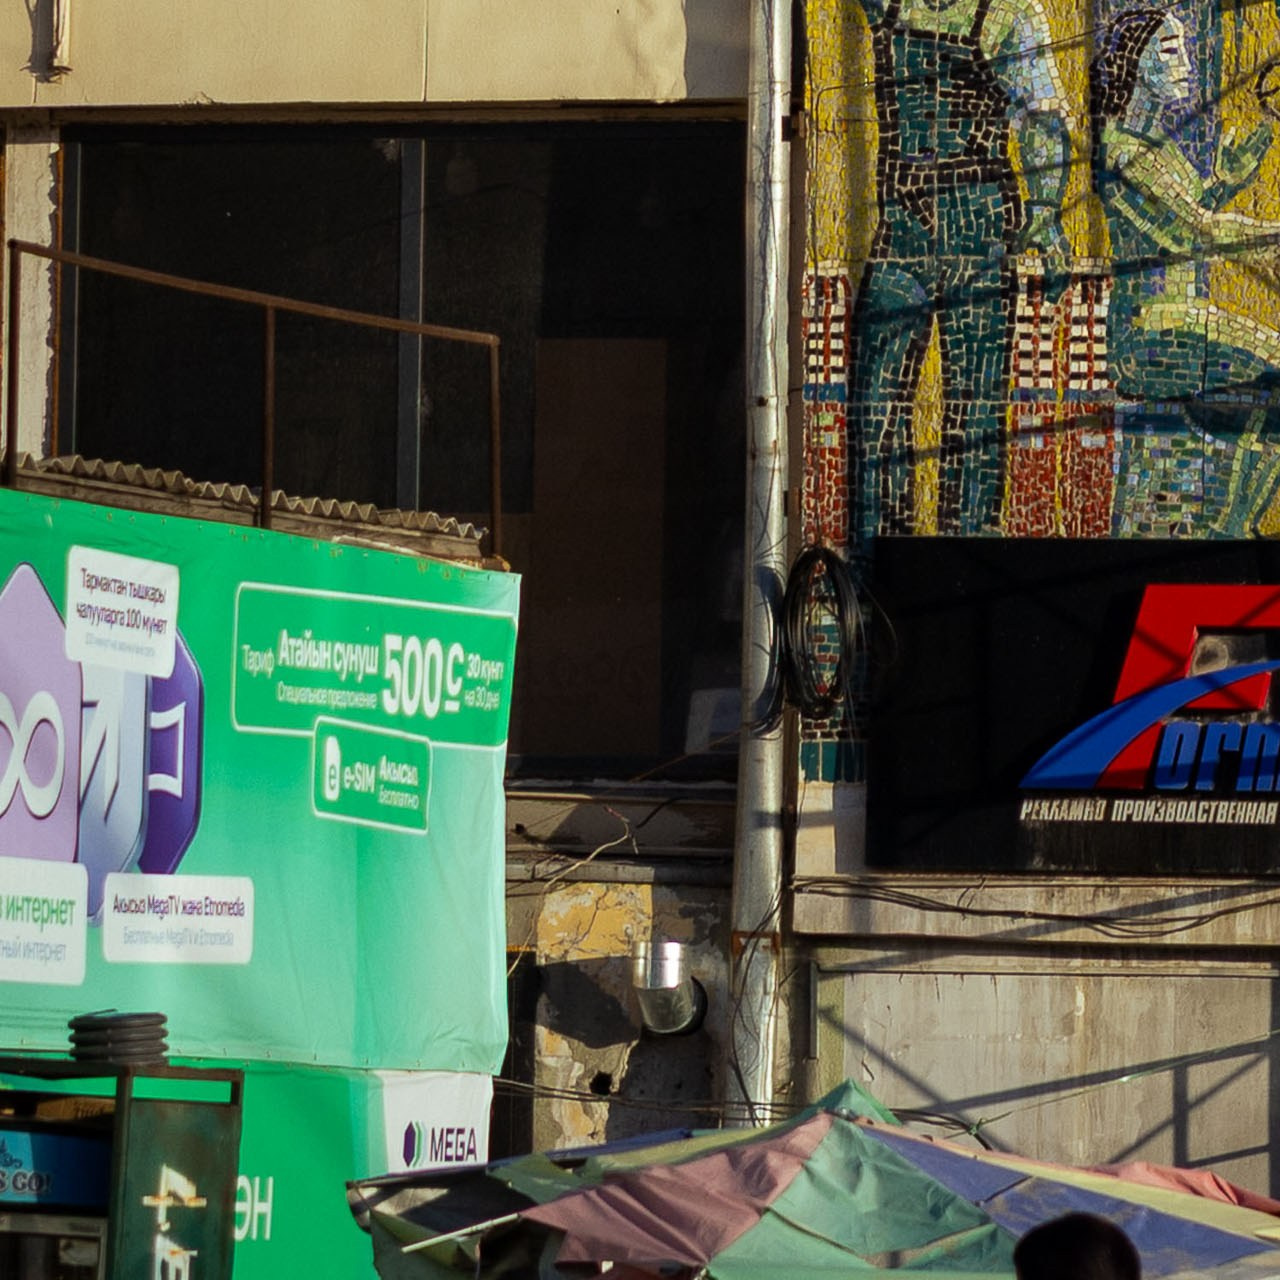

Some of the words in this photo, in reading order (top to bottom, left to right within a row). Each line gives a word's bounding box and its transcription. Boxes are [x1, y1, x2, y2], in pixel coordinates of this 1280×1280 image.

[126, 608, 142, 630] 100
[242, 644, 274, 679] Тариф
[279, 629, 331, 671] Атайын
[333, 643, 379, 683] сунуш
[467, 652, 481, 679] 30
[343, 761, 376, 794] e-SIM
[1111, 799, 1278, 825] ПРОИЗВОДСТВЕННАЯ
[6, 895, 76, 933] интернет
[430, 1126, 477, 1163] MEGA
